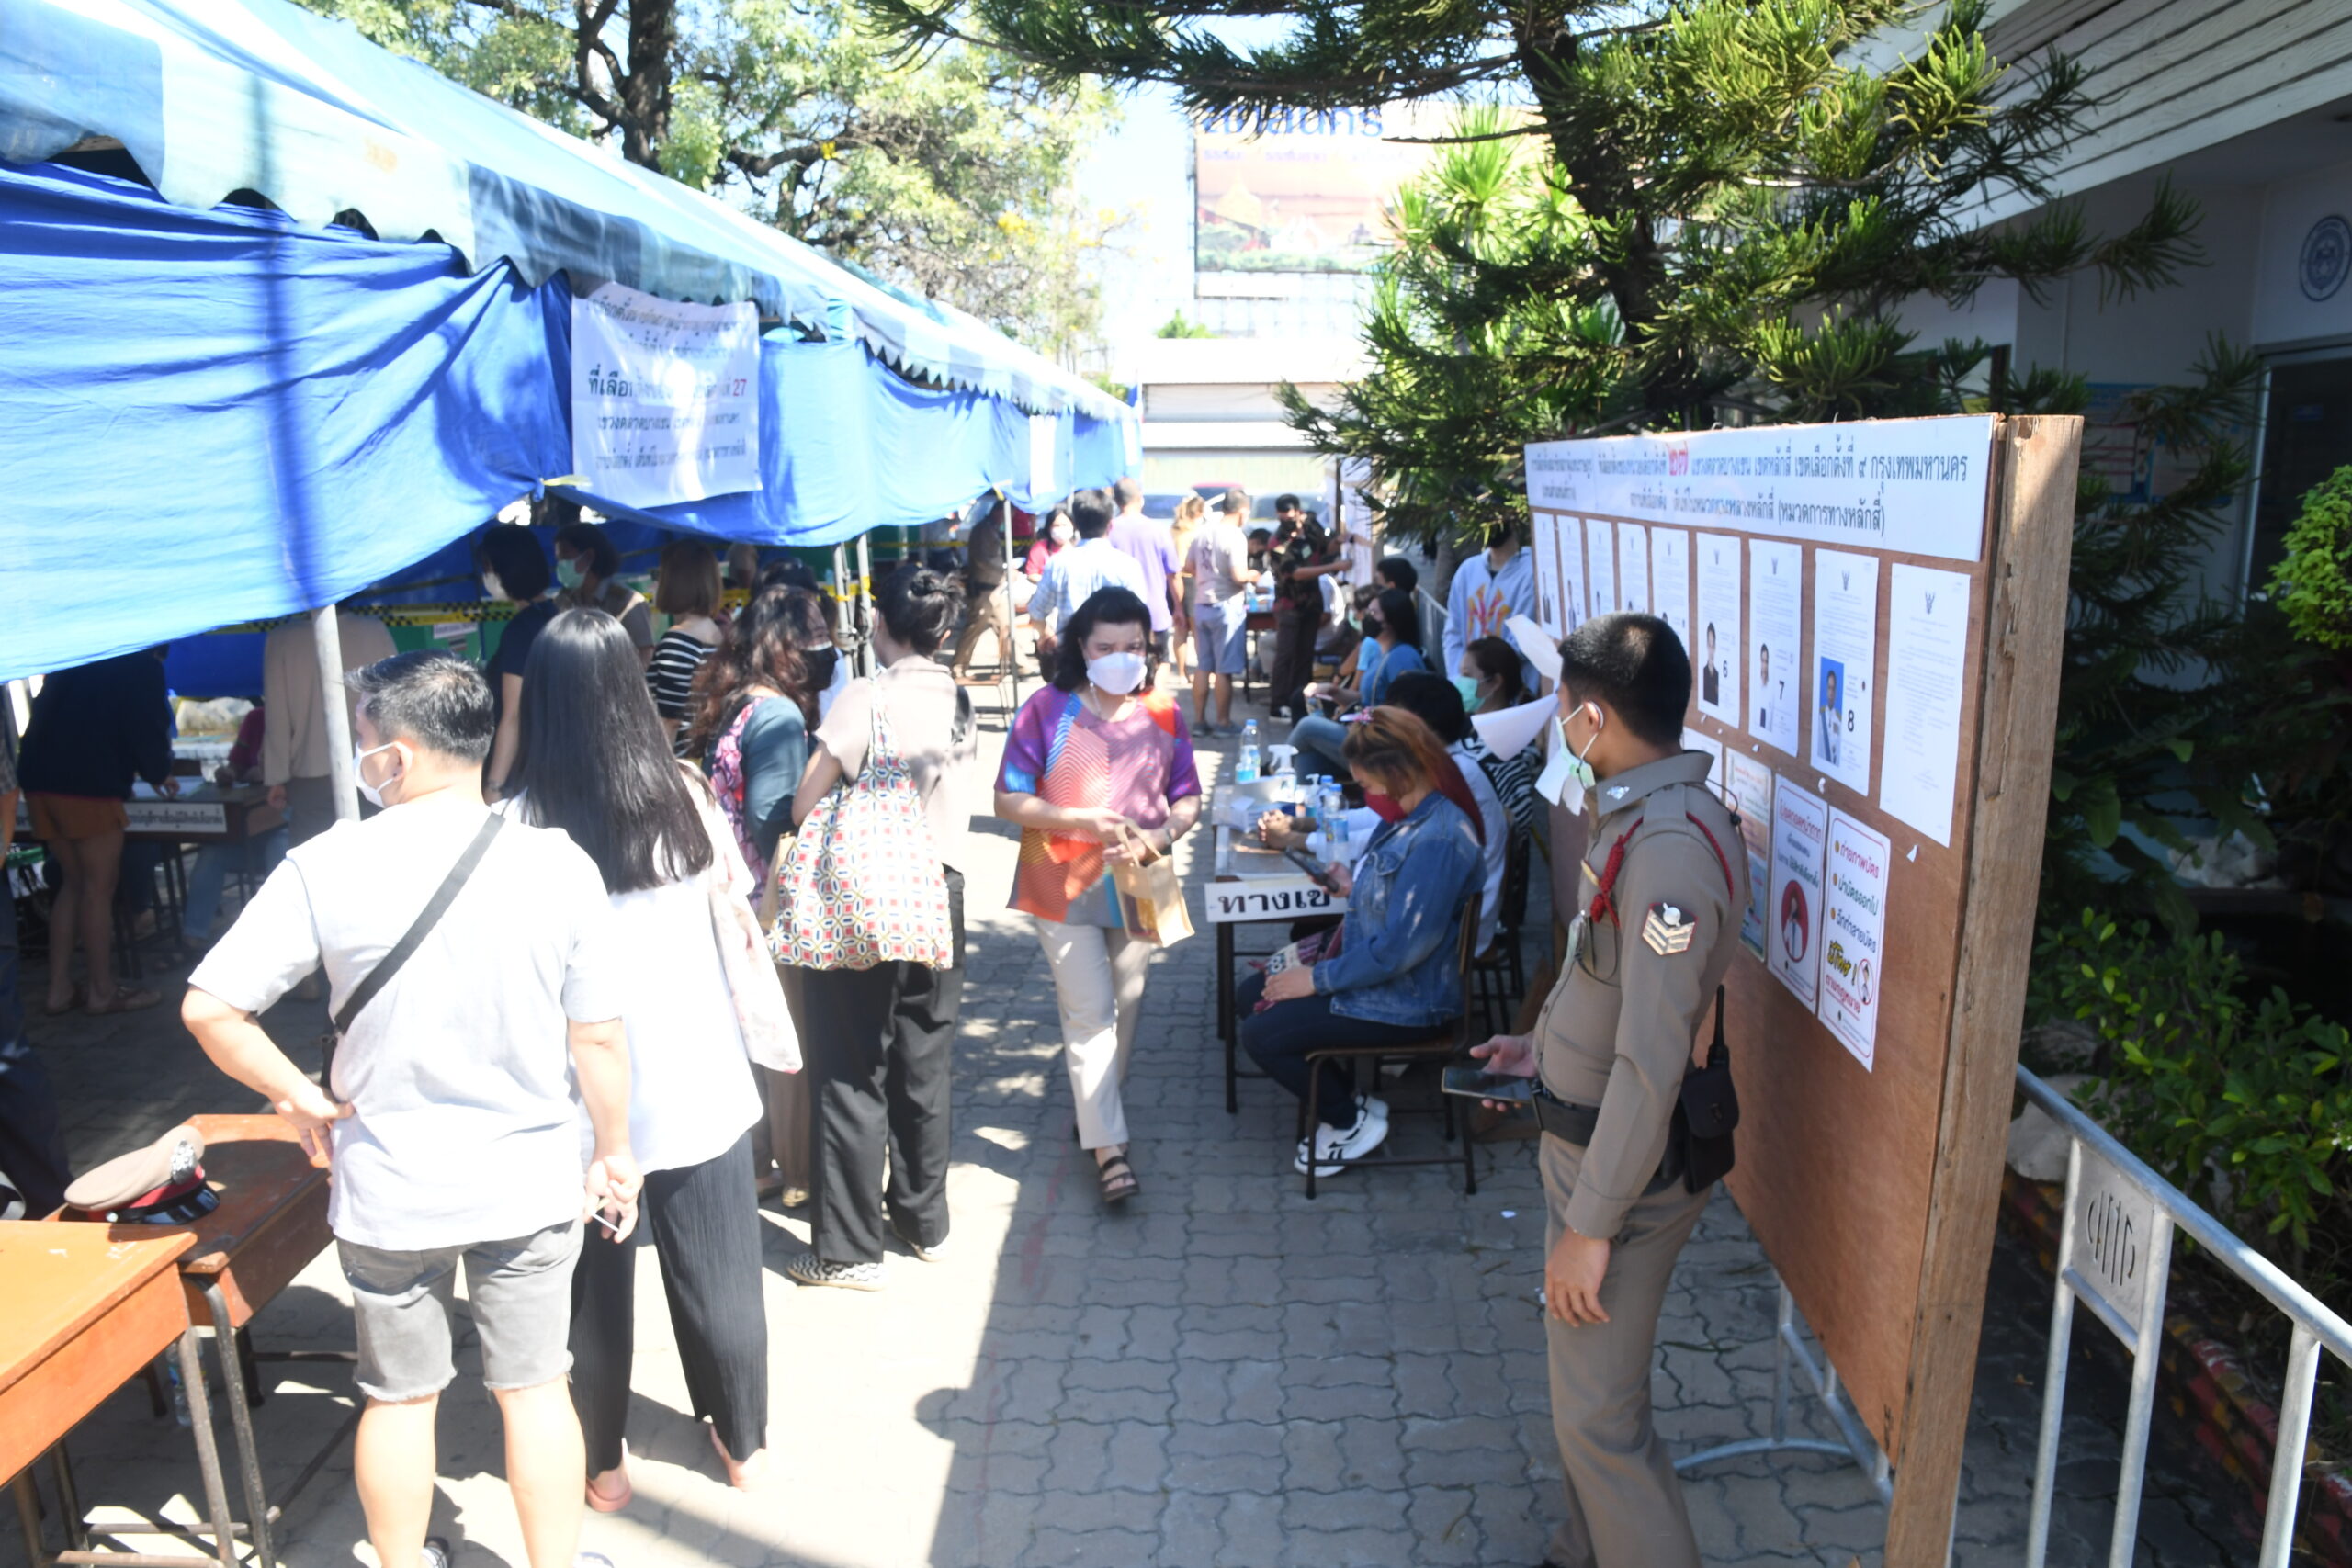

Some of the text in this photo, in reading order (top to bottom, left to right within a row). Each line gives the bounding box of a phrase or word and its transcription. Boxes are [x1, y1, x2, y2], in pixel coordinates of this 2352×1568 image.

[732, 378, 747, 397] 27
[1794, 433, 1854, 479] เขตเลือกตั้งที่
[1871, 454, 1969, 494] กรุงเทพมหานคร
[1778, 491, 1884, 537] (หมวดการทางหลักสี่)
[1723, 660, 1728, 678] 6
[1779, 680, 1785, 700] 7
[1848, 709, 1855, 732] 8
[1217, 889, 1331, 914] ทางเข
